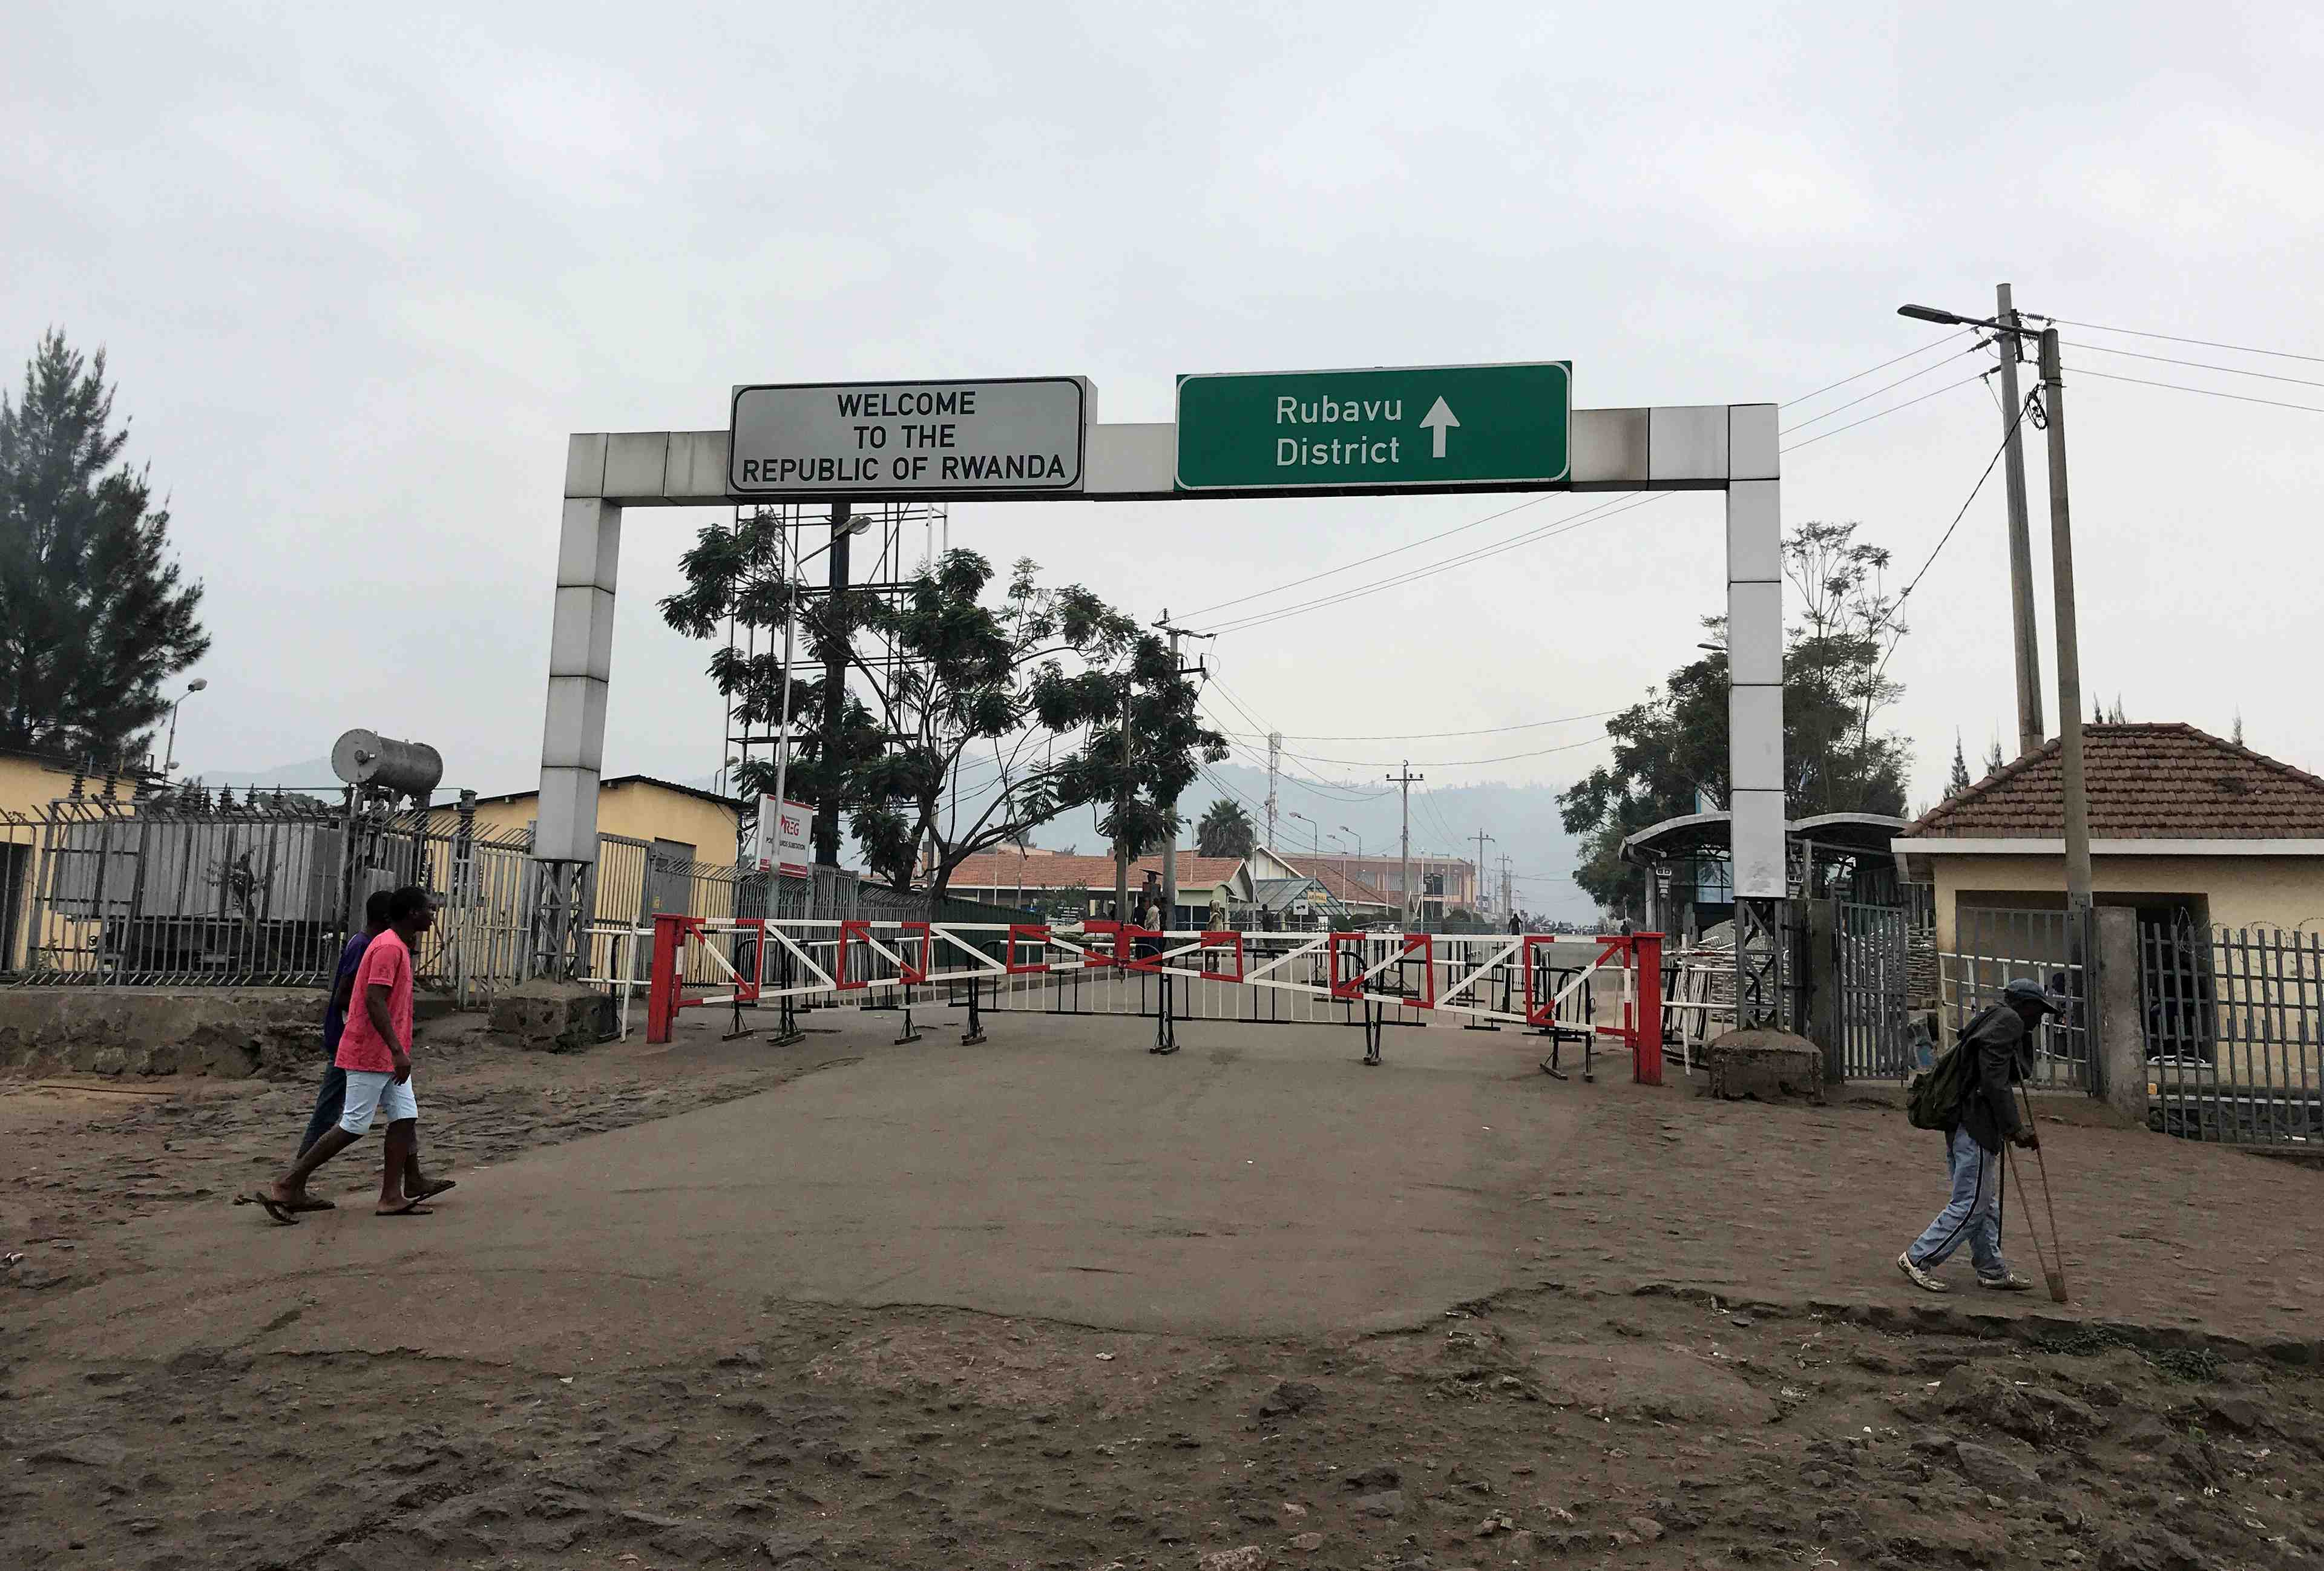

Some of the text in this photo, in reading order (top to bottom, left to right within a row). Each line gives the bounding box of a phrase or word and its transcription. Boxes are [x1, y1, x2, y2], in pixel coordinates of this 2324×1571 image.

[838, 391, 976, 417] WELCOME
[1276, 395, 1402, 424] Rubavu
[853, 424, 956, 449] TO THE
[1276, 436, 1400, 466] District
[743, 454, 1065, 482] REPUBLIC OF RWANDA
[784, 821, 799, 836] REG
